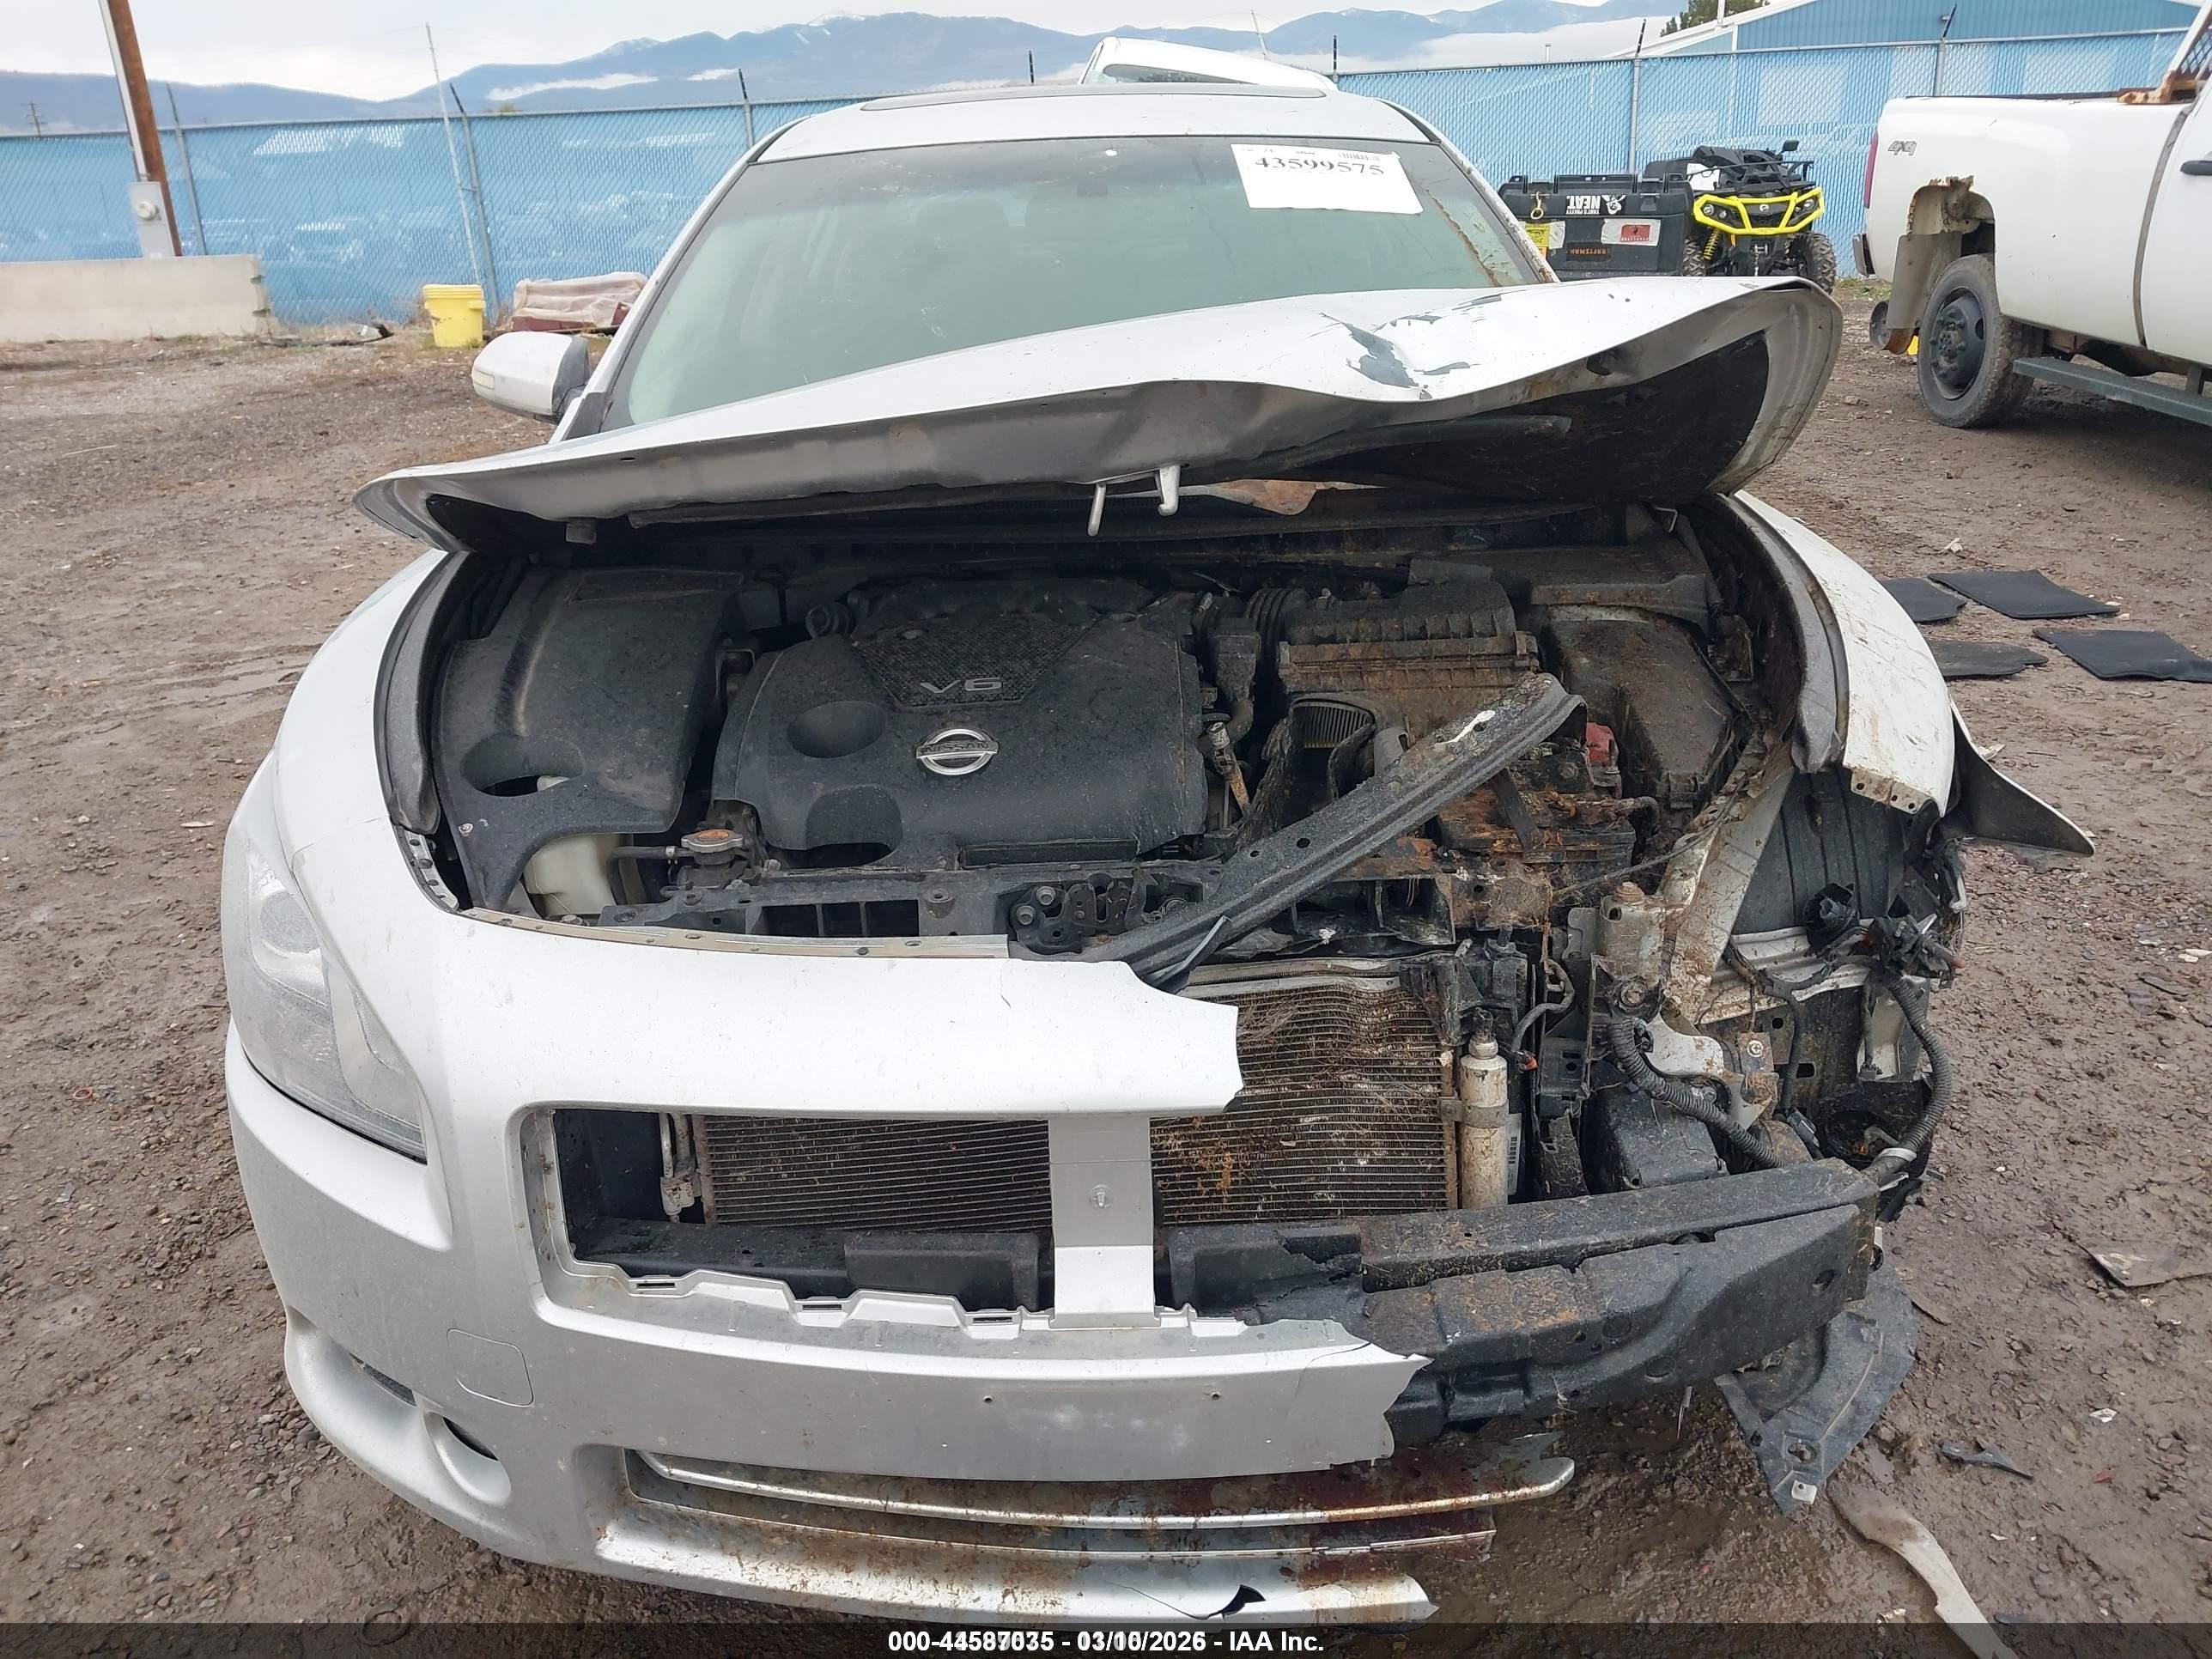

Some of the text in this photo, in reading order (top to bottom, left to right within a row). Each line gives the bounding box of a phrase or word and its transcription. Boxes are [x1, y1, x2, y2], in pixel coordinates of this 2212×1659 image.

[1254, 156, 1385, 176] 43599575
[1565, 195, 1601, 210] NEAT.
[921, 677, 1002, 694] V6
[920, 739, 990, 755] NISSAN
